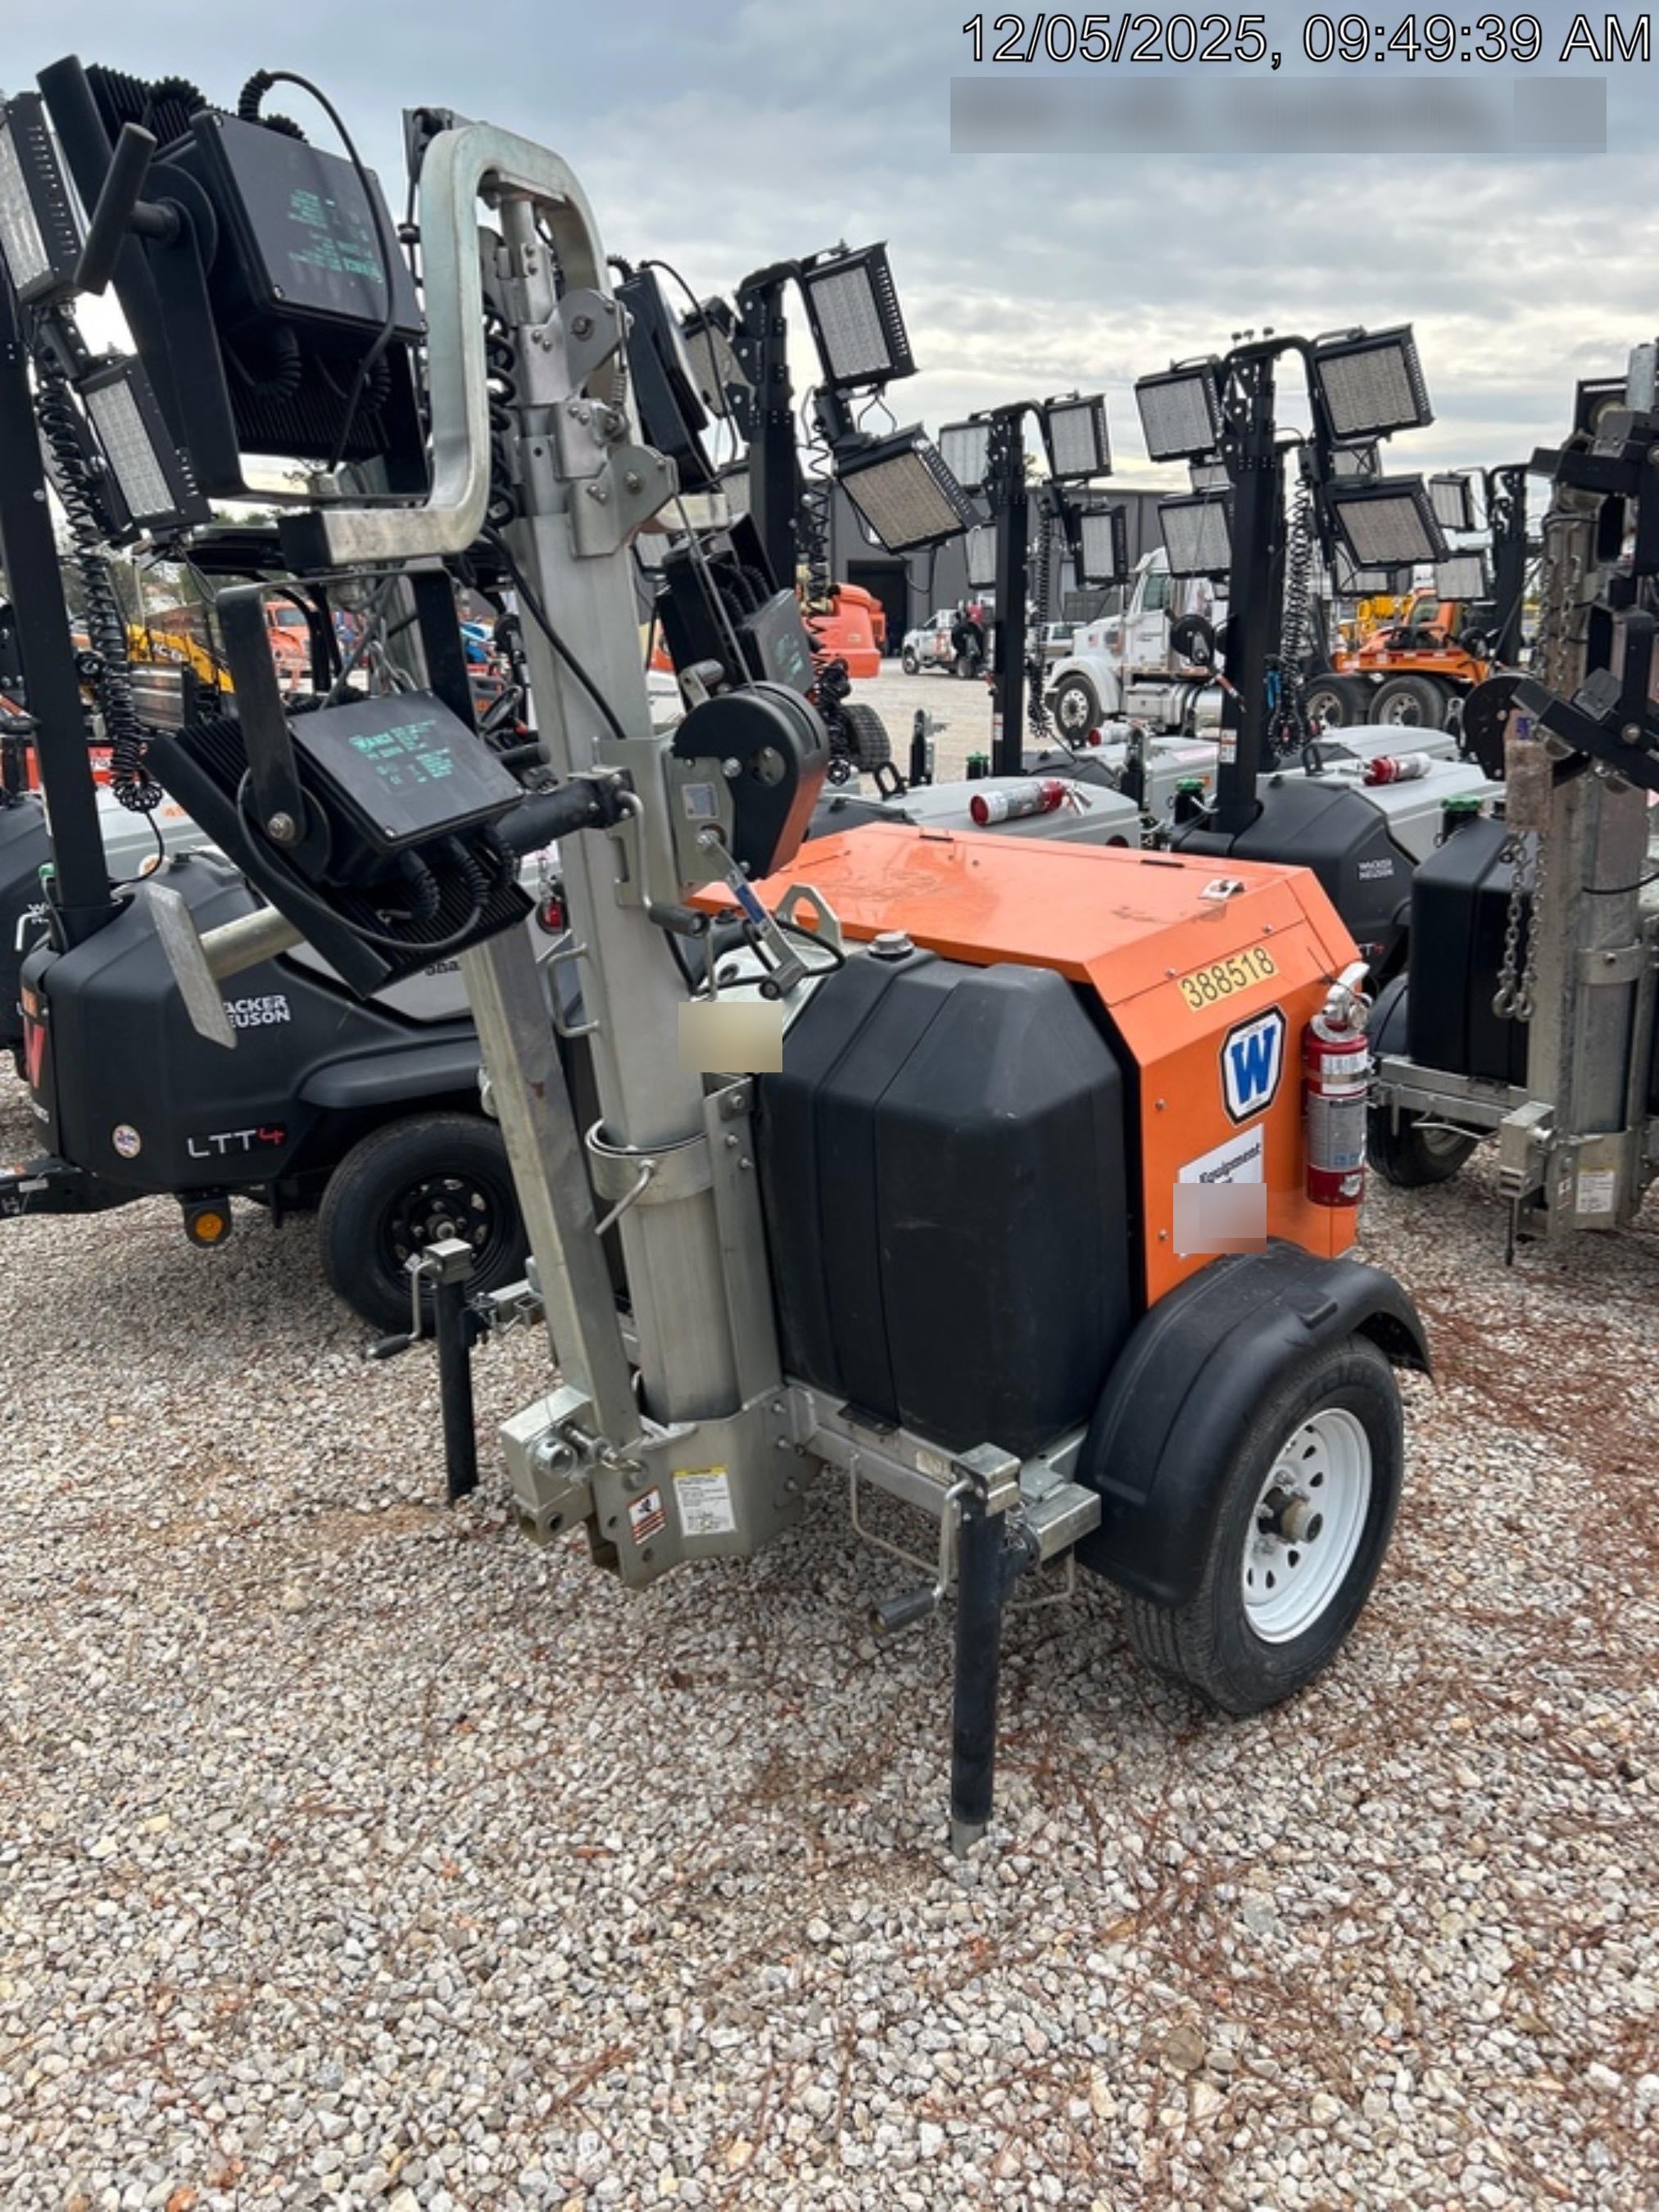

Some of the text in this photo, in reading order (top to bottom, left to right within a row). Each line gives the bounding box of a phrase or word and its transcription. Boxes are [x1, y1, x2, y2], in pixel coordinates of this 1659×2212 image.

[1181, 947, 1275, 1008] 388518
[223, 994, 287, 1013] ACKER
[229, 1009, 291, 1029] EUSON
[1231, 1024, 1276, 1105] W
[187, 1128, 285, 1158] LTT4
